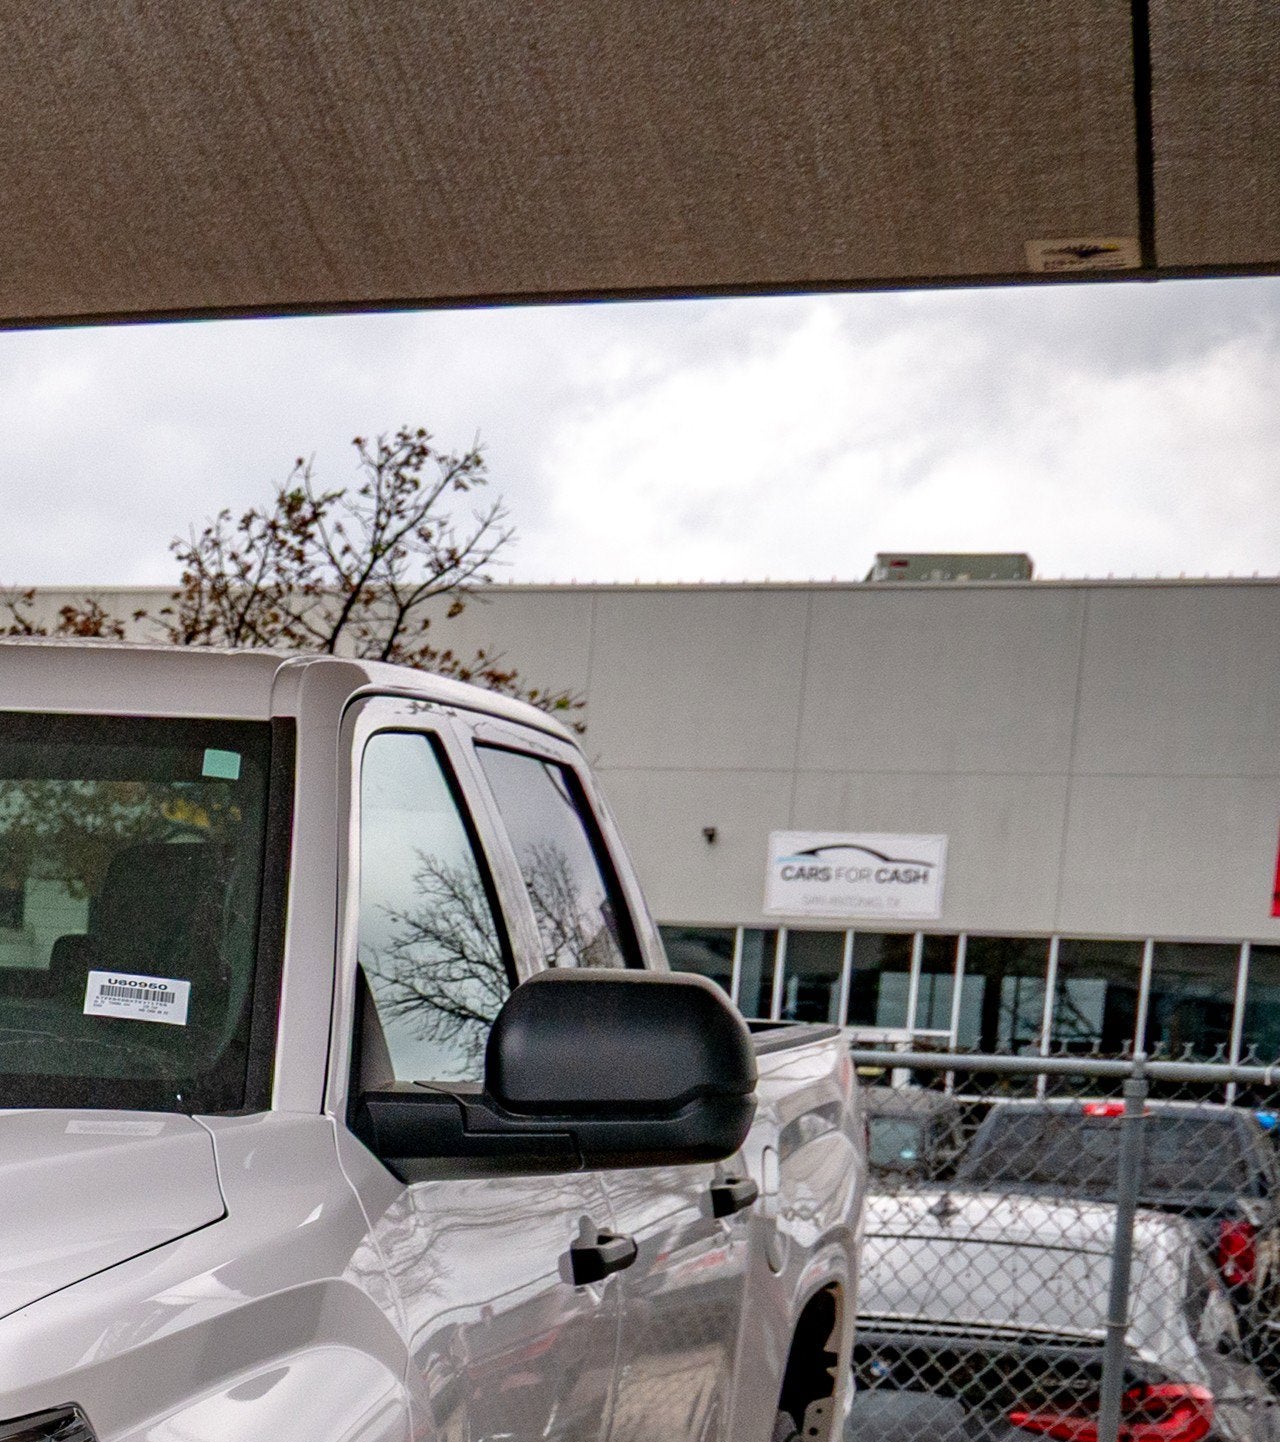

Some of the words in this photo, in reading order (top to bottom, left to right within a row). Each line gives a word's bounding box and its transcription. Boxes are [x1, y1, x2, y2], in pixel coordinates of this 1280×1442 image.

[781, 865, 831, 883] CARS
[835, 866, 871, 884] FOR
[875, 867, 929, 885] CASH
